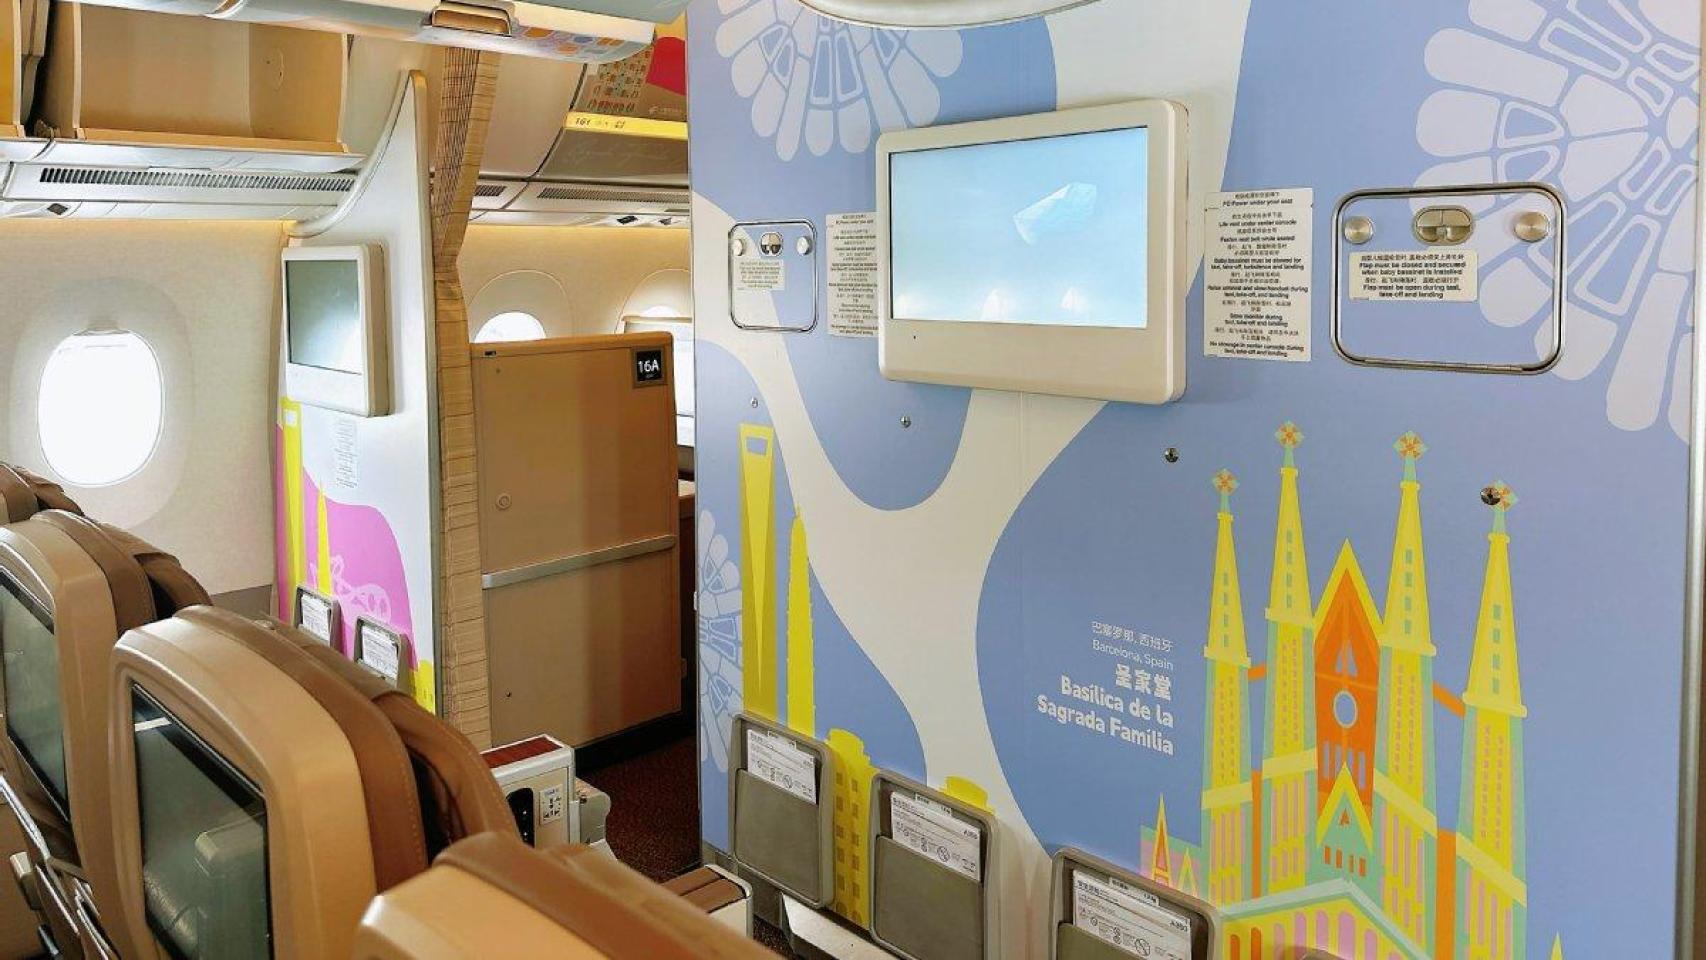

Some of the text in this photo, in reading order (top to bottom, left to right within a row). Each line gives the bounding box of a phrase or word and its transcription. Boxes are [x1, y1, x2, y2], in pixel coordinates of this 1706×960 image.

[637, 359, 659, 373] 16A
[1092, 639, 1174, 671] Barcelona, Spain
[1115, 663, 1172, 701] 圣家堂
[1037, 694, 1106, 734] Sagrada
[1128, 697, 1151, 721] de
[1155, 703, 1174, 728] la
